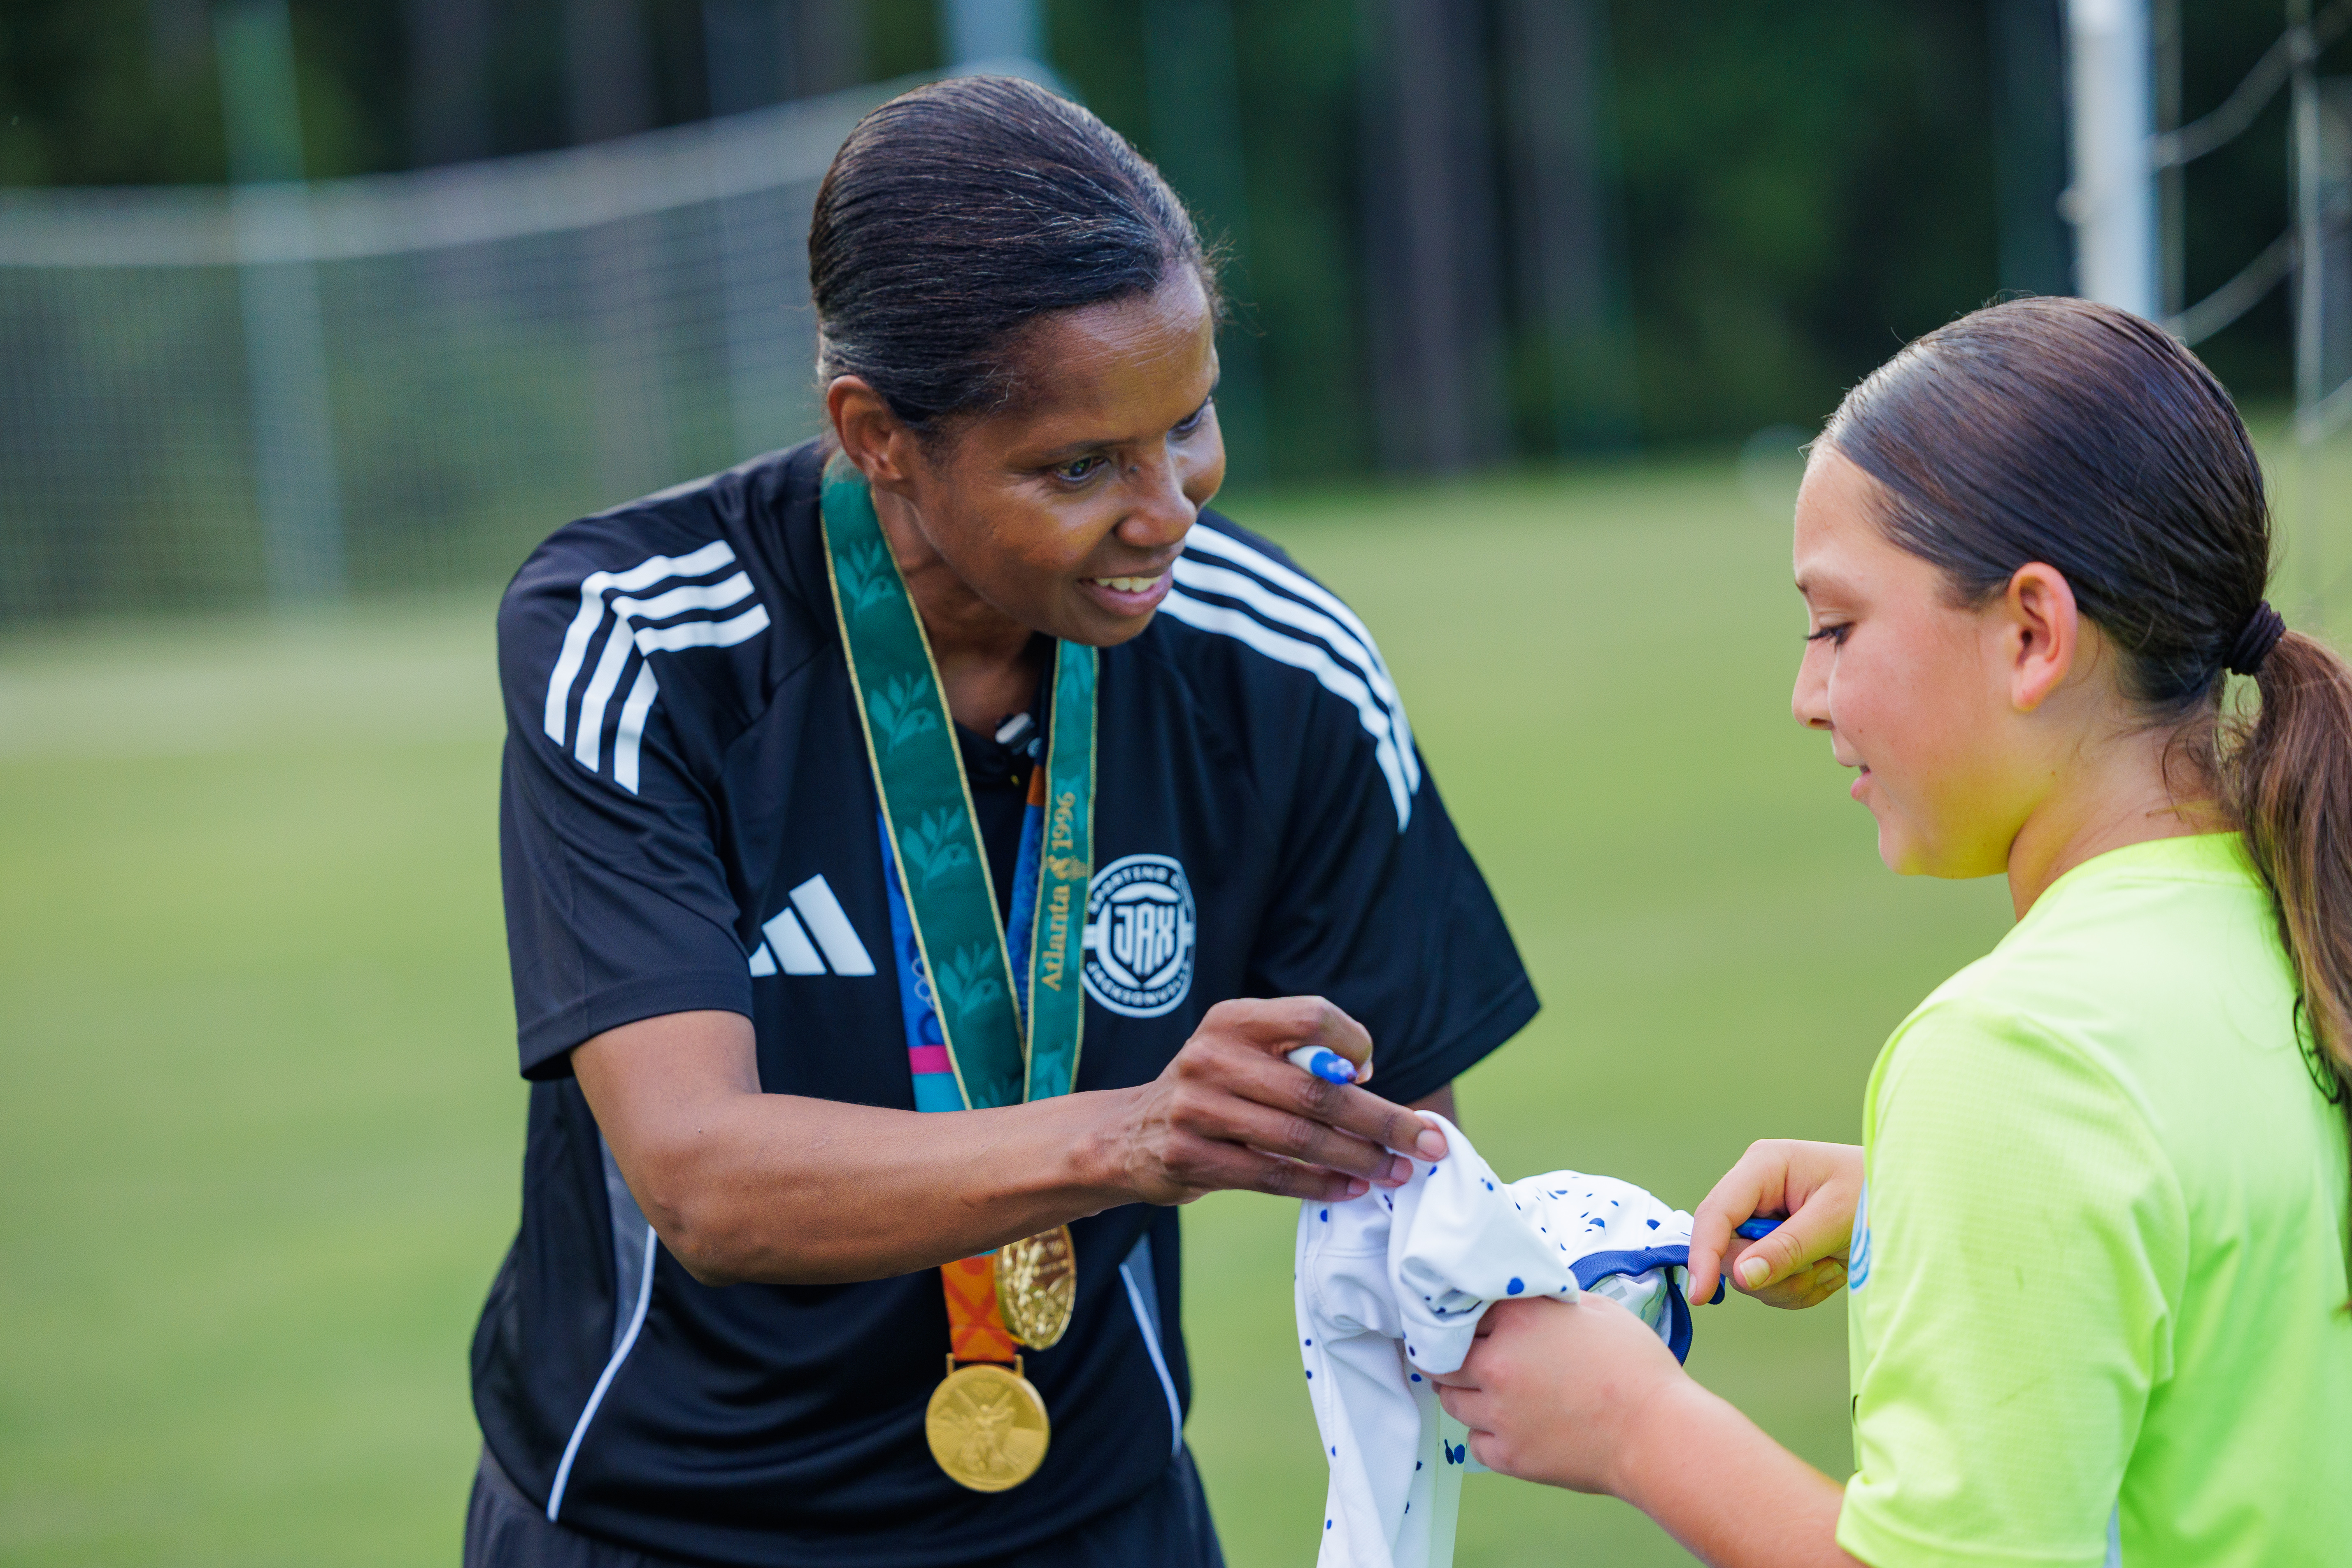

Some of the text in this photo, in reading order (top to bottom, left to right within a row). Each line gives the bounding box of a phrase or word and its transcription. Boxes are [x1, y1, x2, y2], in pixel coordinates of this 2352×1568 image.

[1041, 791, 1076, 991] Atlanta 1996
[1114, 901, 1175, 976] JAX
